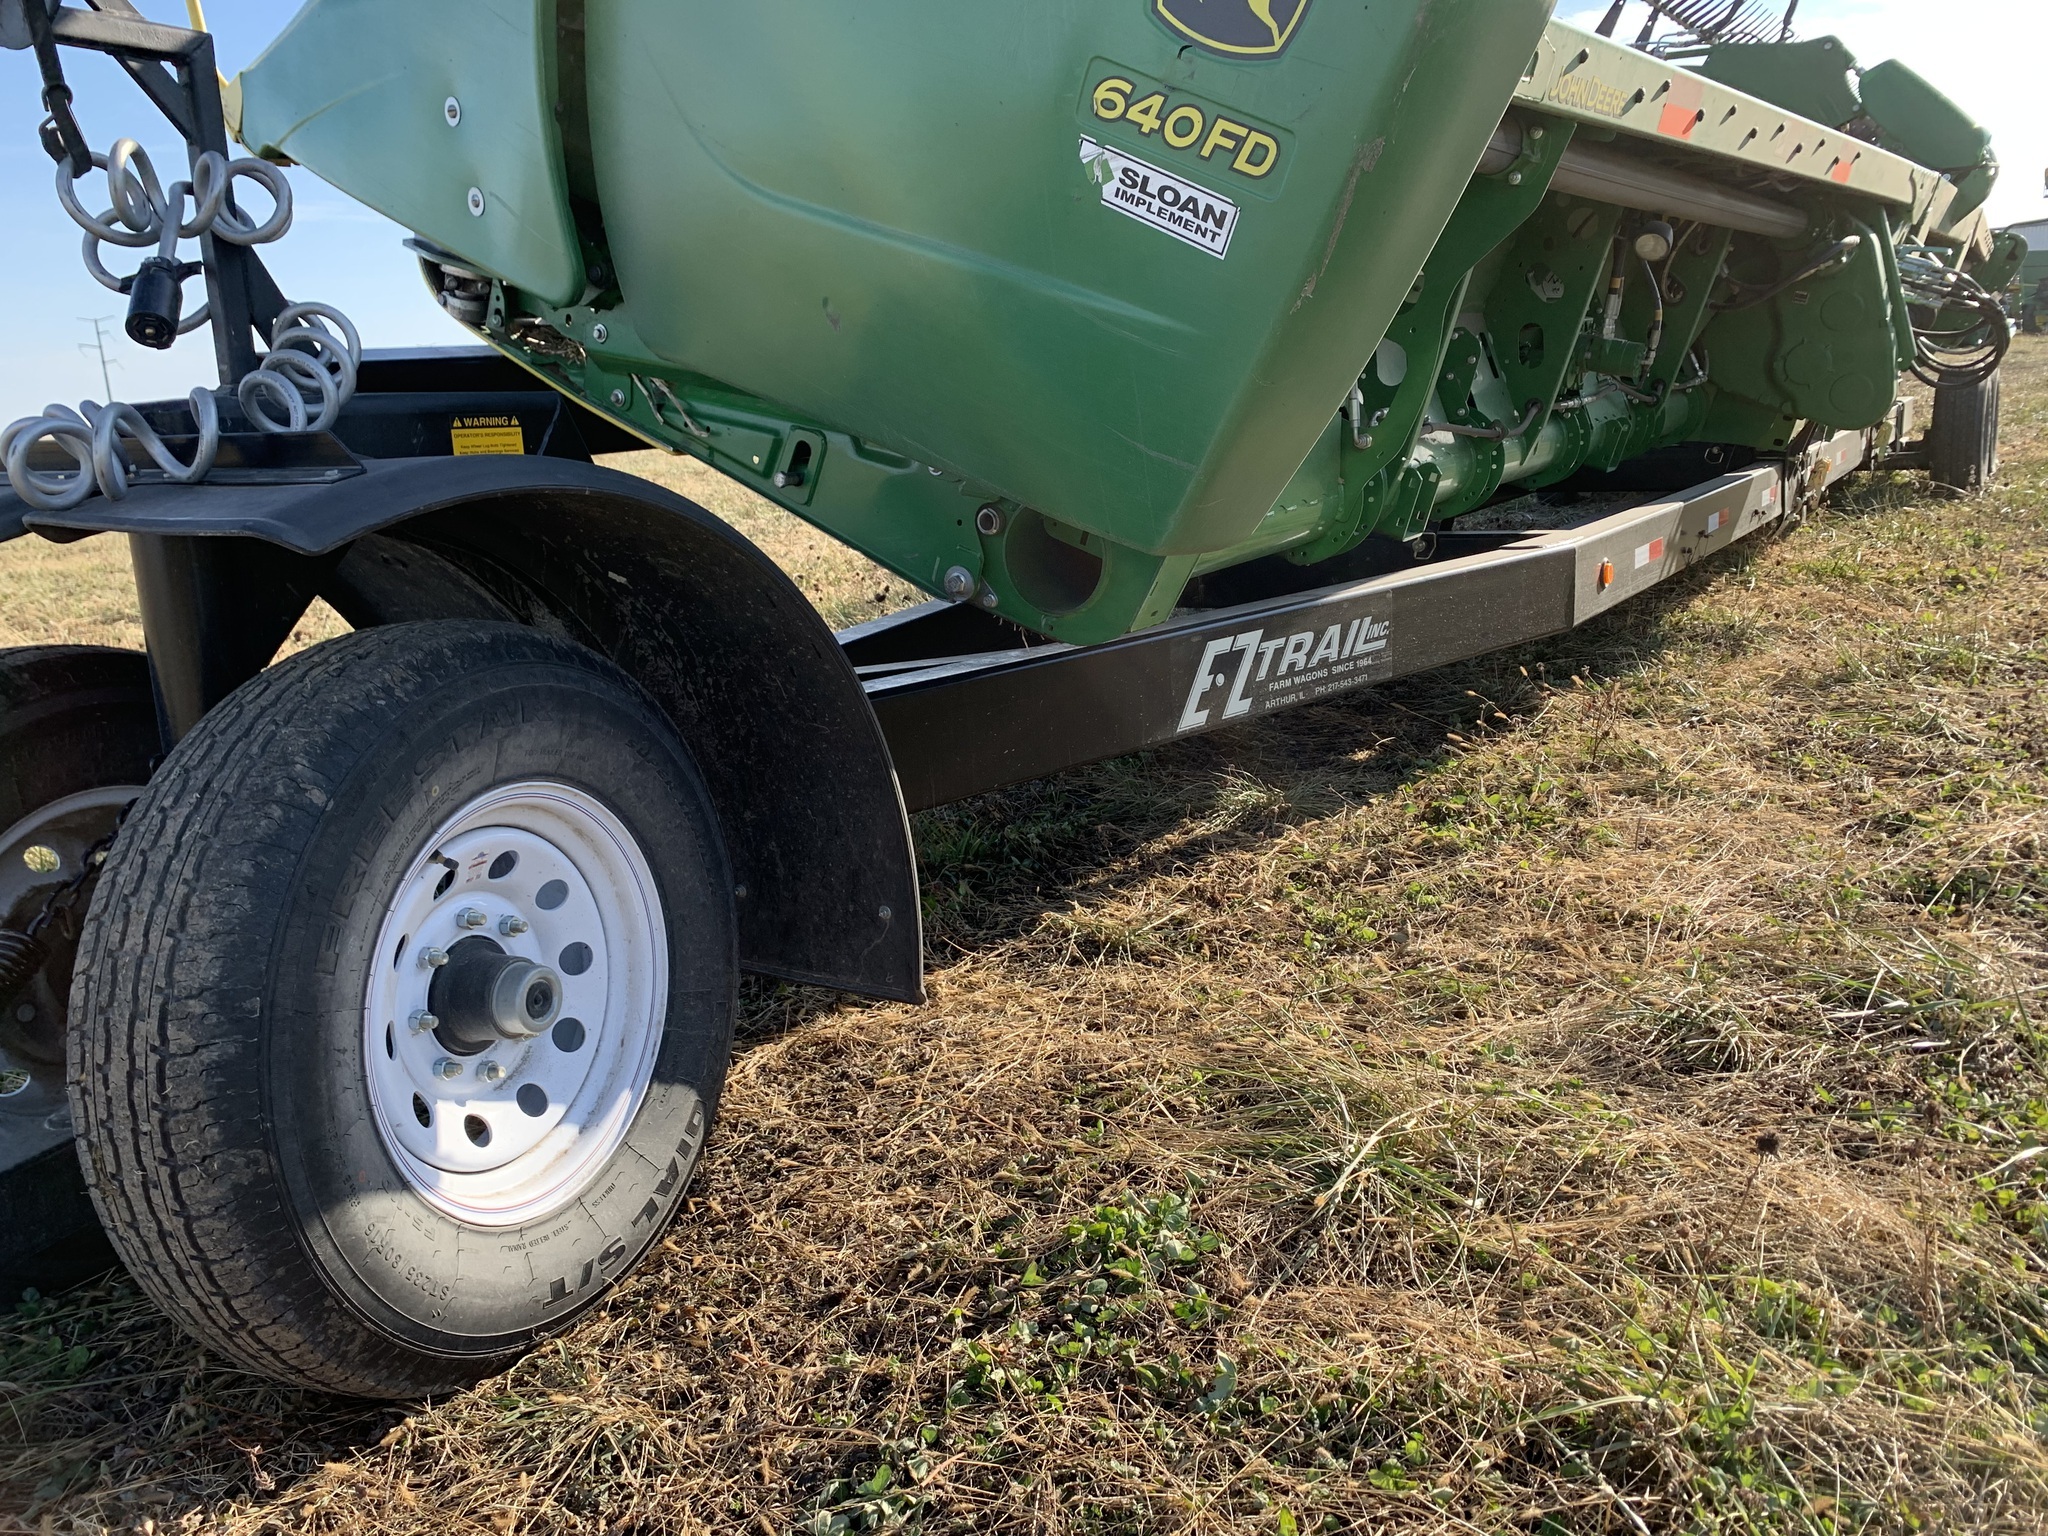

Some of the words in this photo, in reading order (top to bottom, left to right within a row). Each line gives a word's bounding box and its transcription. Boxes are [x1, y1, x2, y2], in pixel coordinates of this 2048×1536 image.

[1549, 65, 1590, 108] JOHN
[1585, 75, 1630, 119] DEERE
[1093, 77, 1280, 179] 640FD
[1114, 187, 1221, 243] IMPLEMENT
[1118, 167, 1228, 230] SLOAN
[463, 416, 509, 427] WARNING
[1255, 615, 1387, 682] TRAIL
[1366, 620, 1391, 640] INC.
[1269, 678, 1292, 692] FARM
[1293, 669, 1329, 685] WAGONS
[1331, 662, 1355, 675] SINCE
[1356, 657, 1373, 668] 1964
[1265, 694, 1298, 710] ARTHUR,
[1299, 691, 1306, 700] IL
[1315, 686, 1327, 696] PH:
[1327, 674, 1369, 692] 217-543-3471
[542, 1236, 627, 1310] S/T
